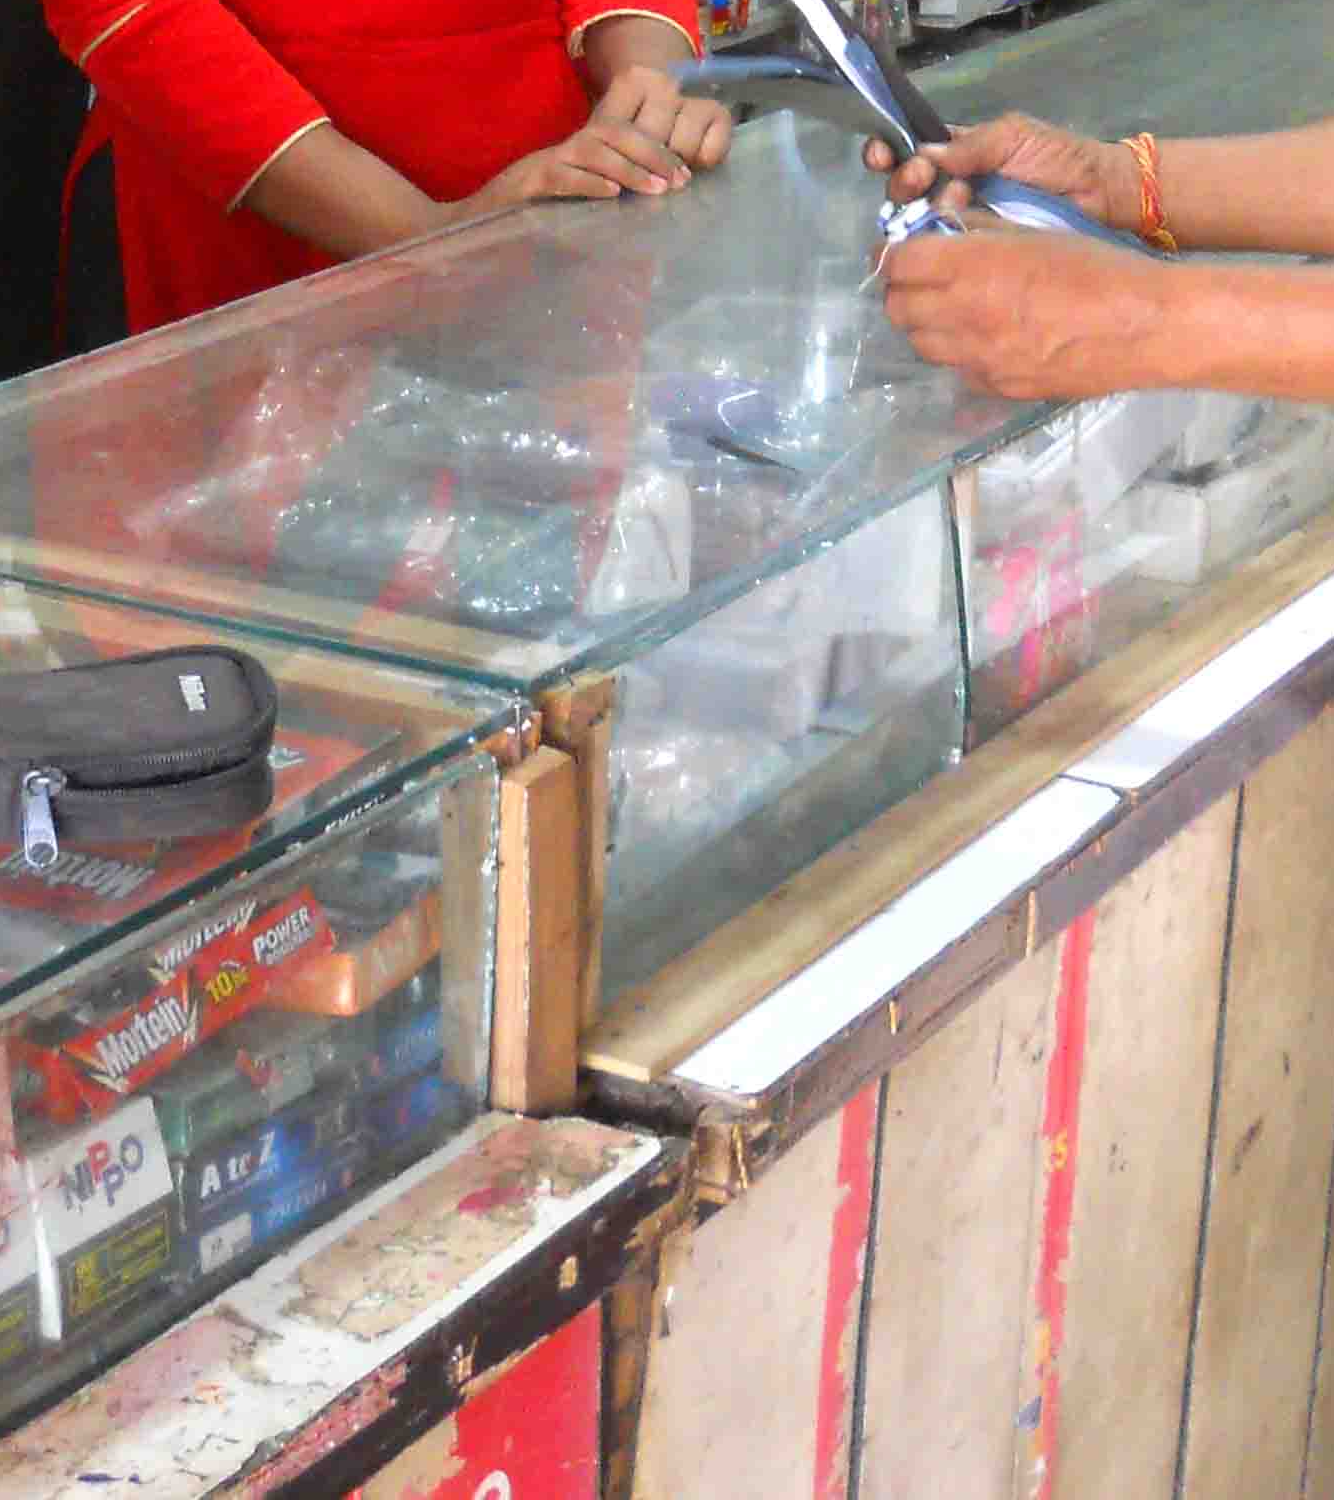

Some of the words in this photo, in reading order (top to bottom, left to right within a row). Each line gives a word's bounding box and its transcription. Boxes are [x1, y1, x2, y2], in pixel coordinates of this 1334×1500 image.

[252, 906, 311, 965] POWER
[95, 995, 189, 1078] Mortein
[64, 1134, 144, 1210] NIPPO
[200, 1160, 222, 1199] A
